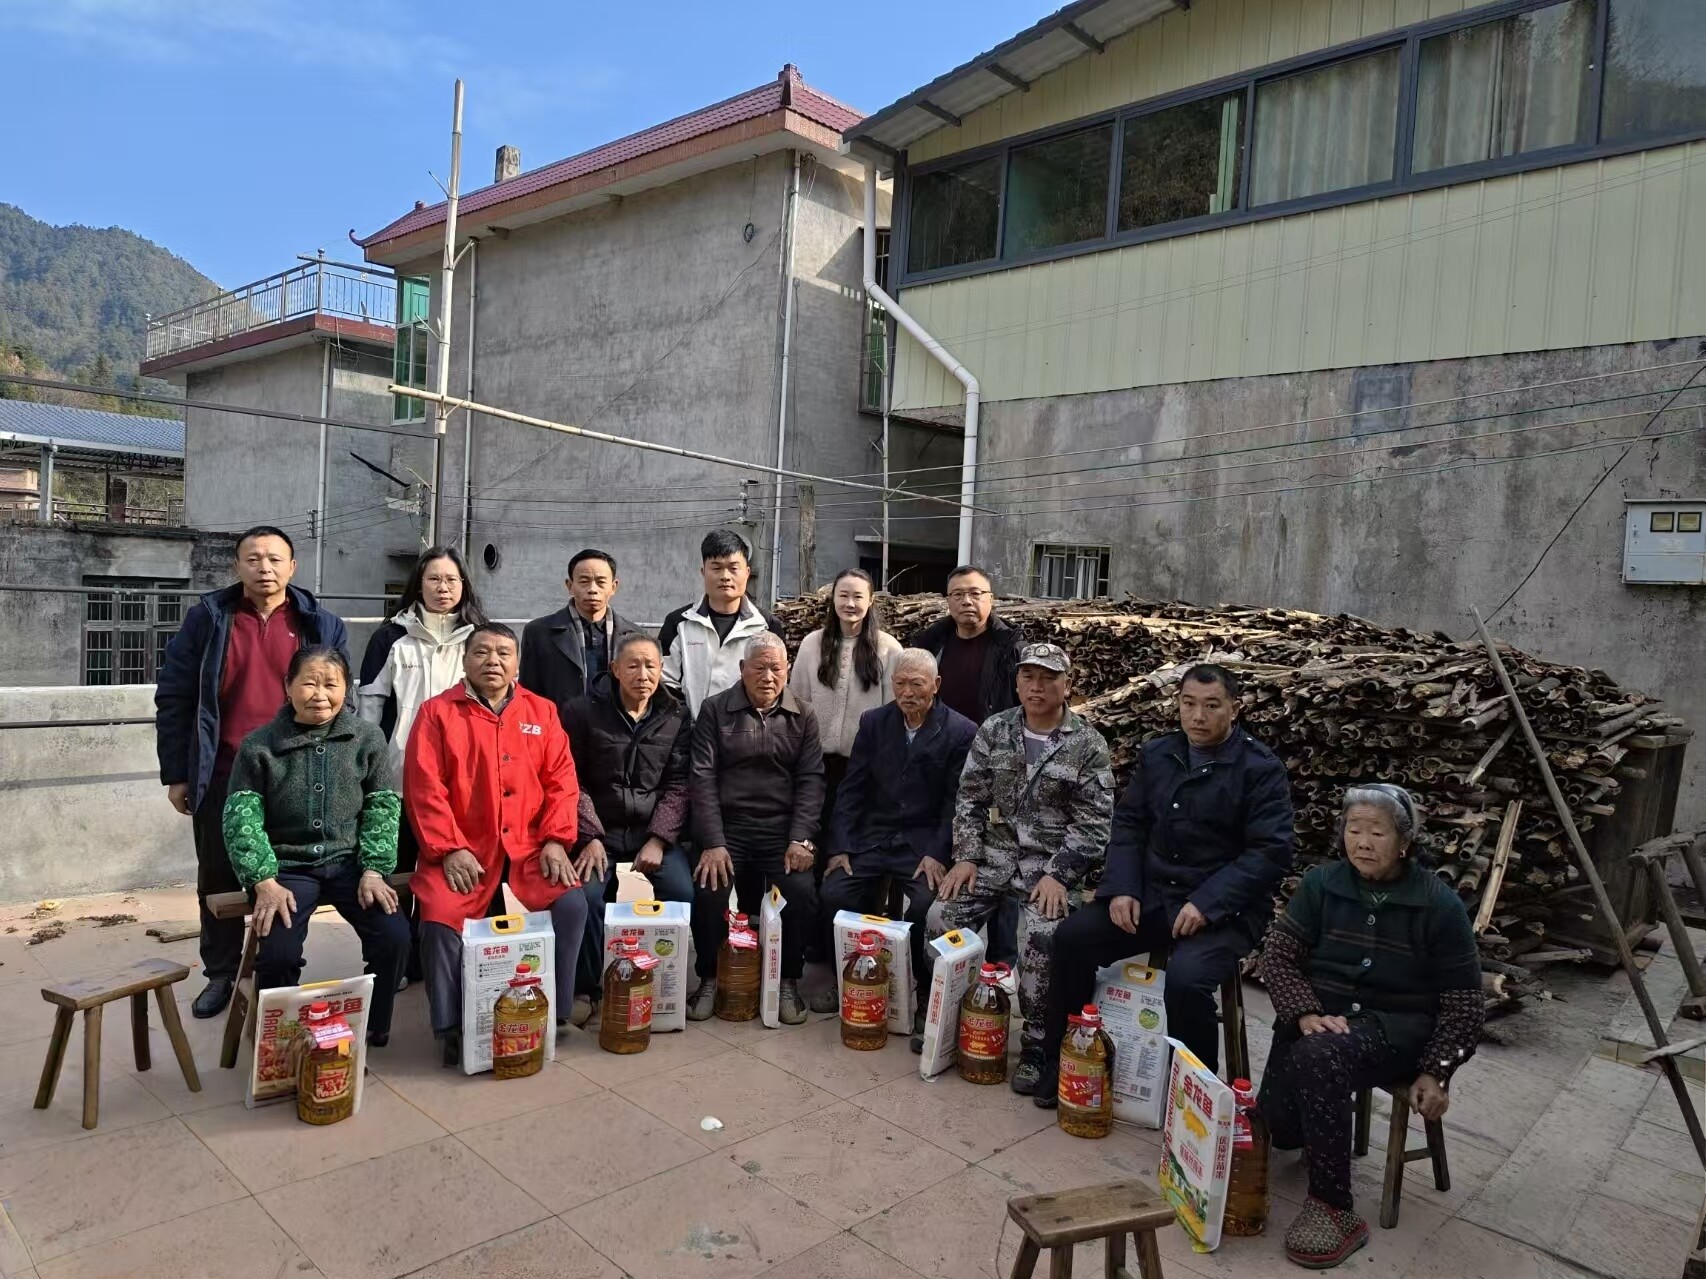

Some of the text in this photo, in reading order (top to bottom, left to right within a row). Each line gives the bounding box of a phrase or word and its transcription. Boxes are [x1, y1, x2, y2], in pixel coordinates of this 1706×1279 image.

[621, 928, 645, 937] 金龙鱼
[483, 945, 509, 956] 金龙鱼
[848, 986, 874, 997] 金龙鱼
[1106, 986, 1132, 1000] 金龙鱼
[967, 1016, 994, 1028] 金龙鱼
[499, 1023, 529, 1033] 金龙鱼
[1183, 1074, 1213, 1120] 金龙鱼
